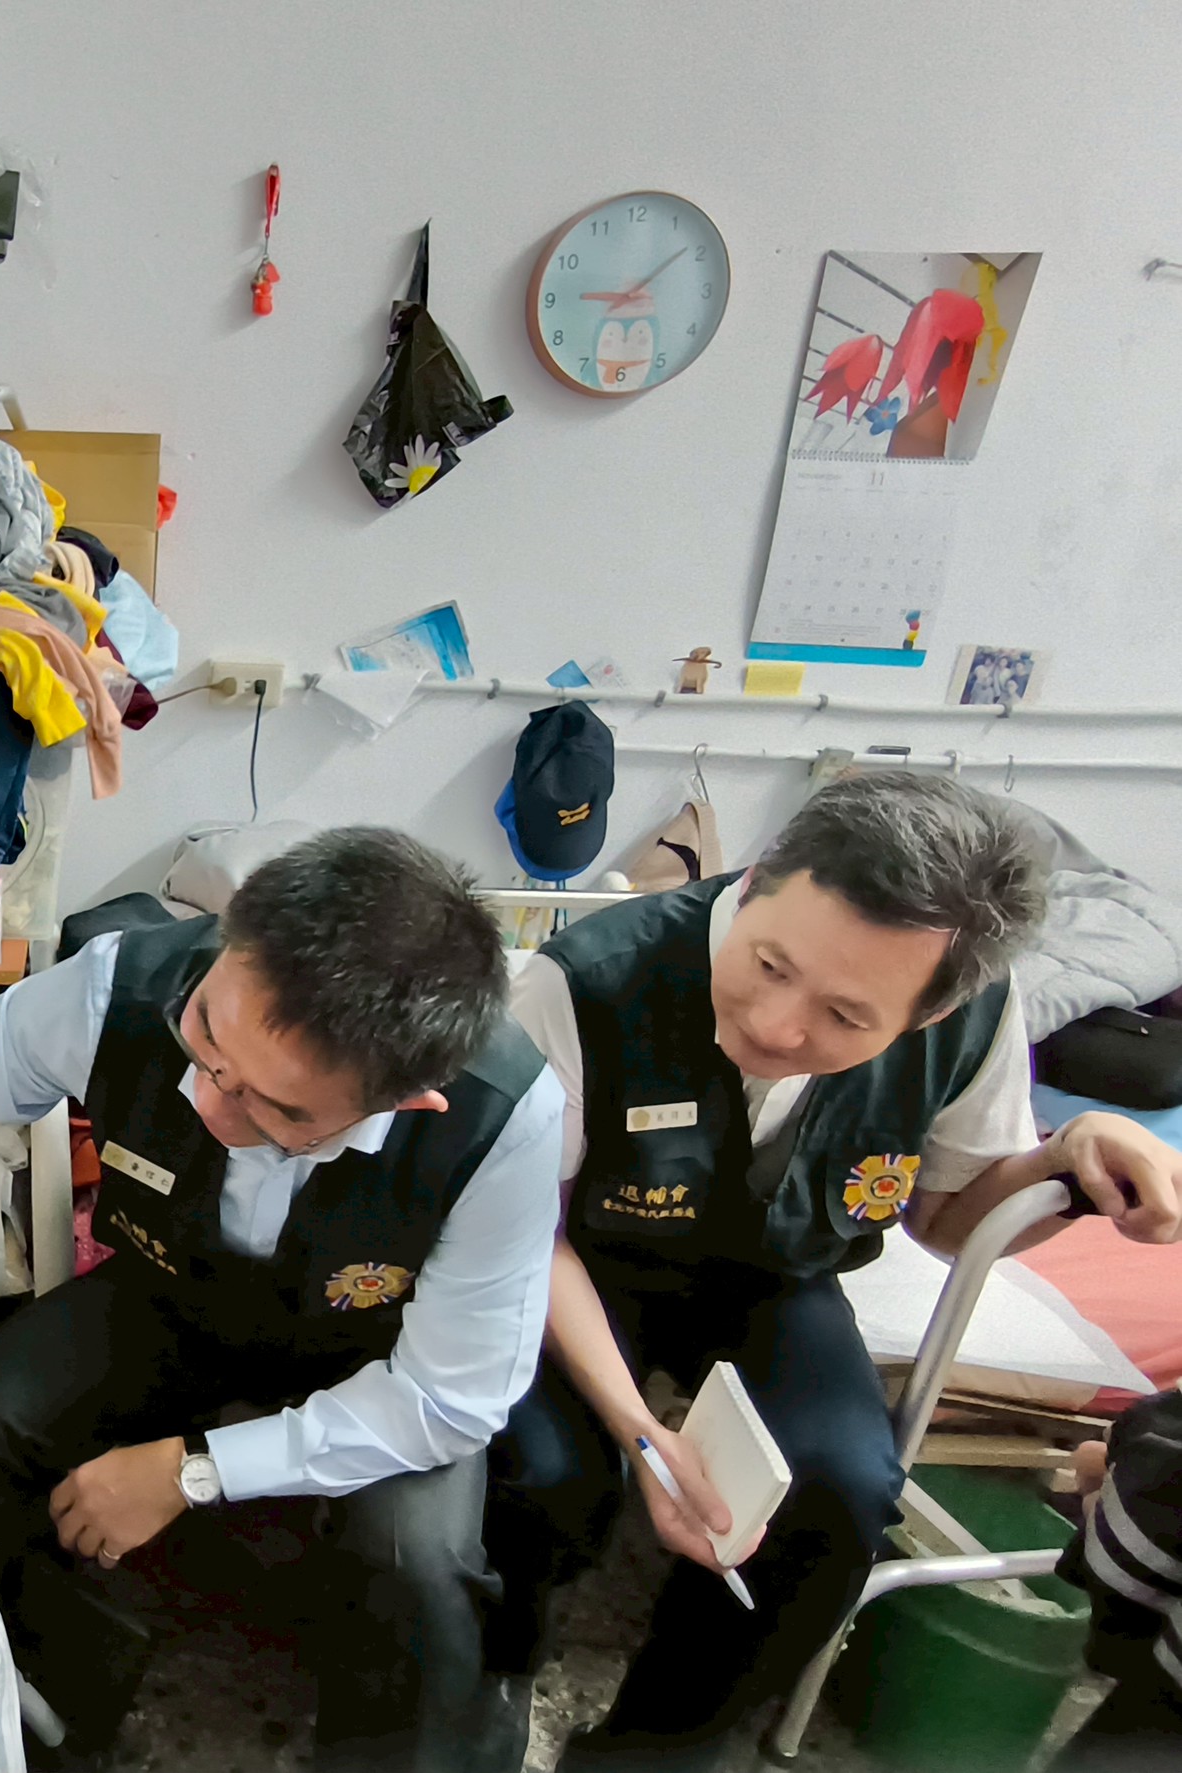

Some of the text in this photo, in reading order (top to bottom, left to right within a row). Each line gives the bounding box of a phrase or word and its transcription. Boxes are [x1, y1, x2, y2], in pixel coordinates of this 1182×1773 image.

[627, 206, 648, 222] 12
[590, 221, 610, 236] 11
[671, 216, 679, 230] 1
[695, 245, 707, 262] 2
[558, 254, 579, 270] 10
[701, 283, 712, 300] 3
[544, 293, 556, 308] 9
[686, 322, 697, 337] 4
[552, 330, 564, 346] 8
[578, 358, 589, 373] 7
[656, 353, 667, 368] 5
[615, 366, 626, 382] 6
[869, 470, 885, 486] 11
